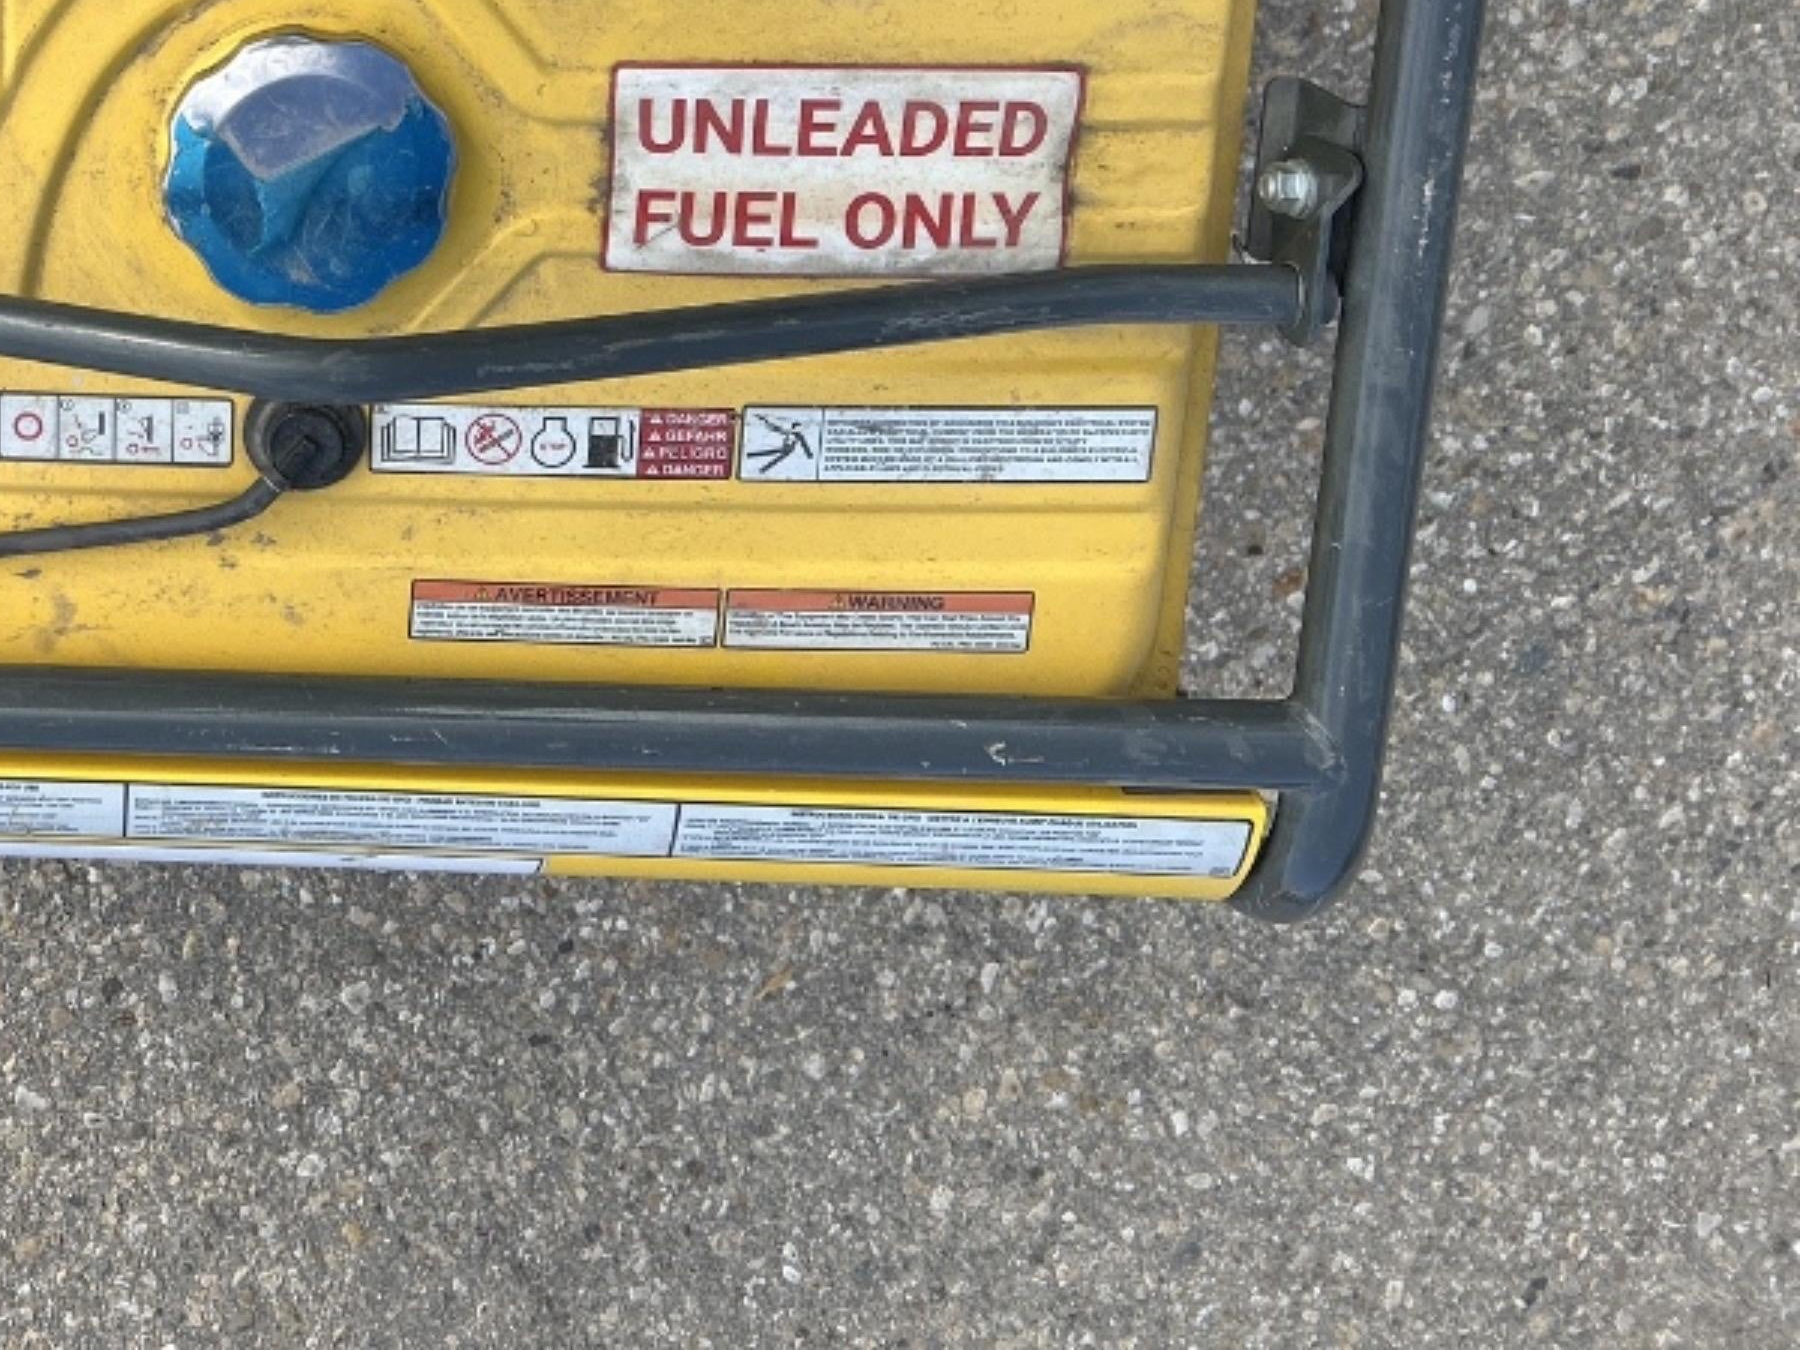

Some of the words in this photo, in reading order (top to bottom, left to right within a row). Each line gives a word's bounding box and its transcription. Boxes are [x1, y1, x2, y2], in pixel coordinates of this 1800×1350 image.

[637, 97, 1049, 157] UNLEADED
[632, 188, 820, 250] FUEL
[844, 190, 1041, 251] ONLY
[495, 586, 661, 606] AVERTISSEMENT
[848, 594, 945, 611] WARNING
